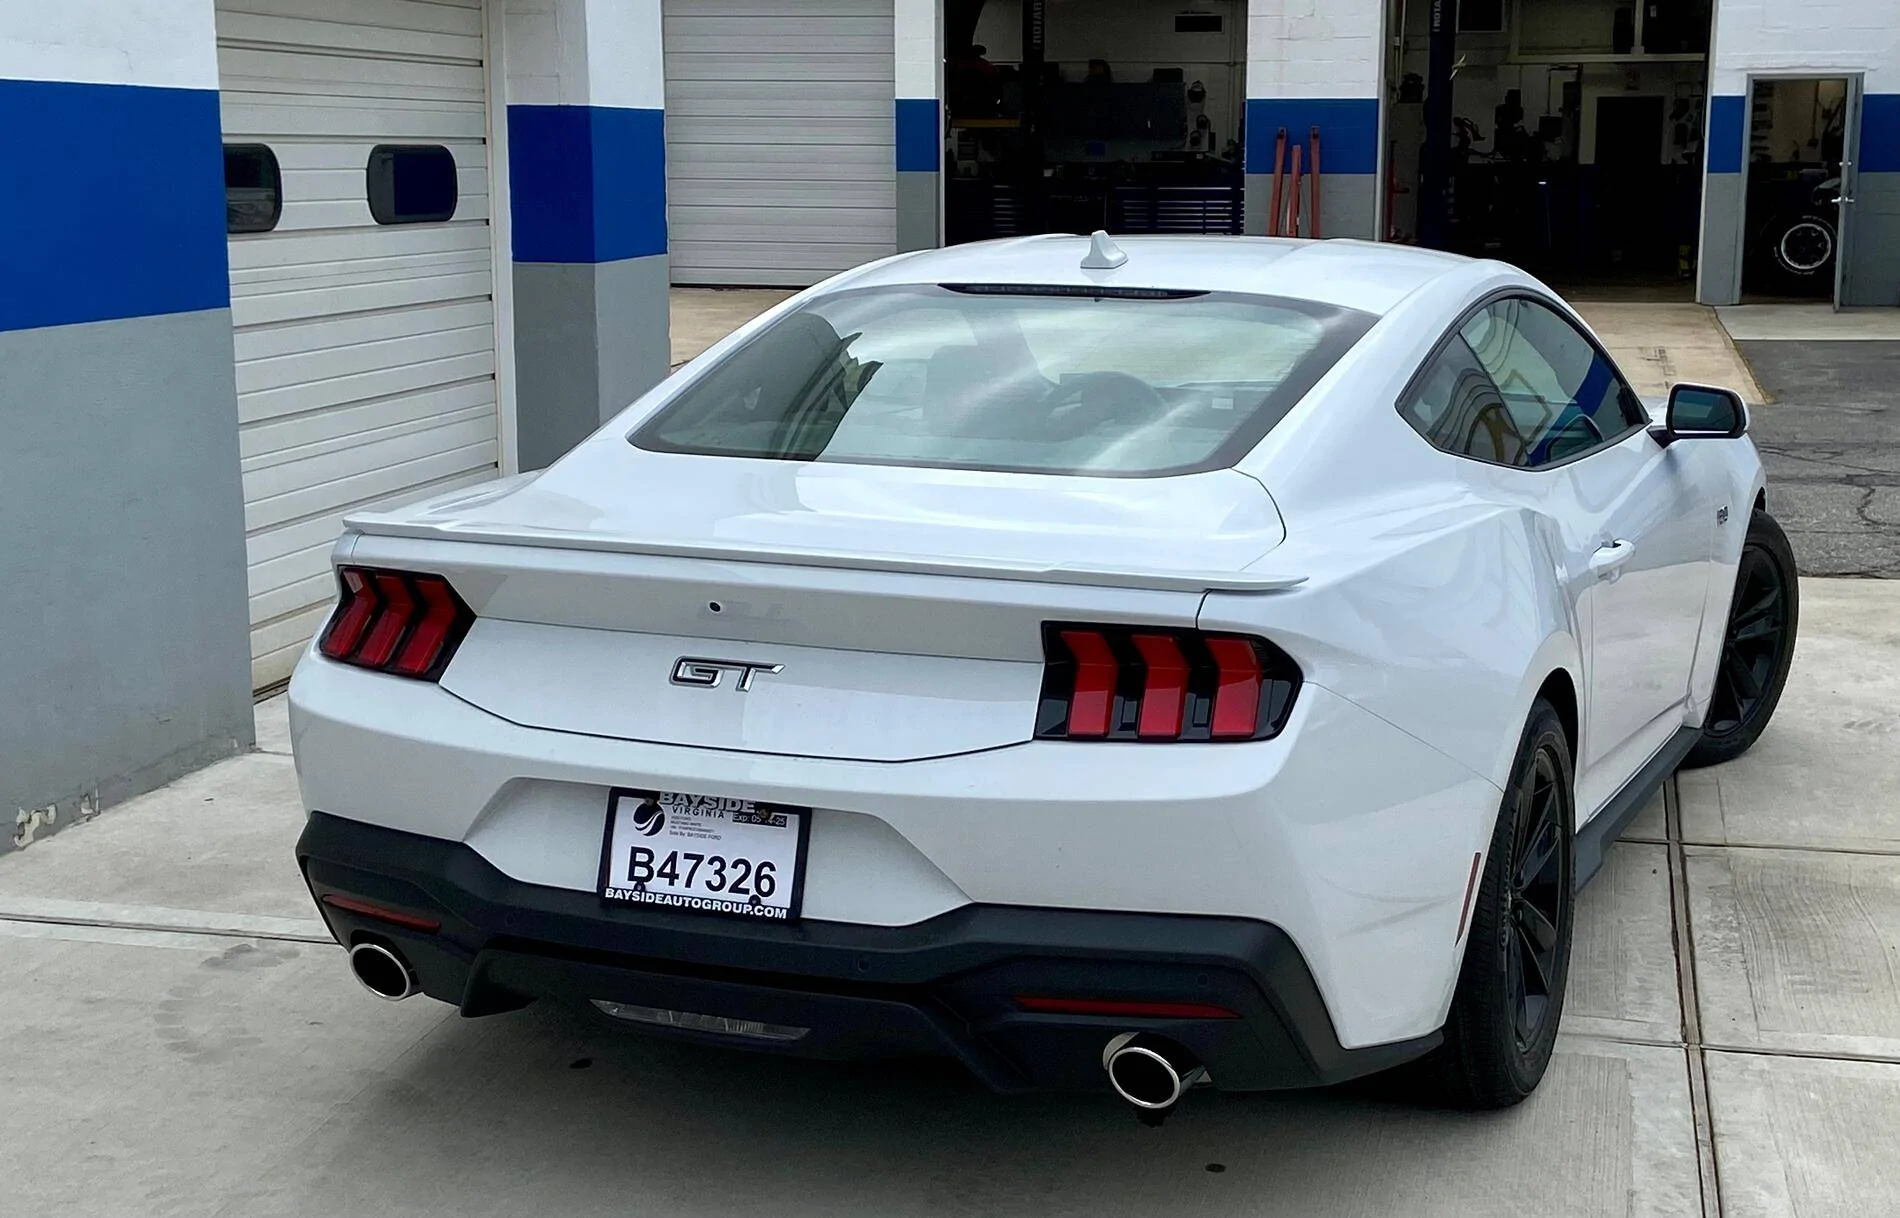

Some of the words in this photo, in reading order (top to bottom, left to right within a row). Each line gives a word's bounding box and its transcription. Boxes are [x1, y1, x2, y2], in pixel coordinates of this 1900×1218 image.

[1032, 0, 1042, 43] ROTAR
[669, 656, 786, 692] GT
[660, 791, 756, 813] BAYSIDE
[672, 806, 724, 819] VIRGINIA
[627, 846, 777, 897] B47326
[605, 887, 787, 919] BAYSIDEAUTOGROUP.COM
